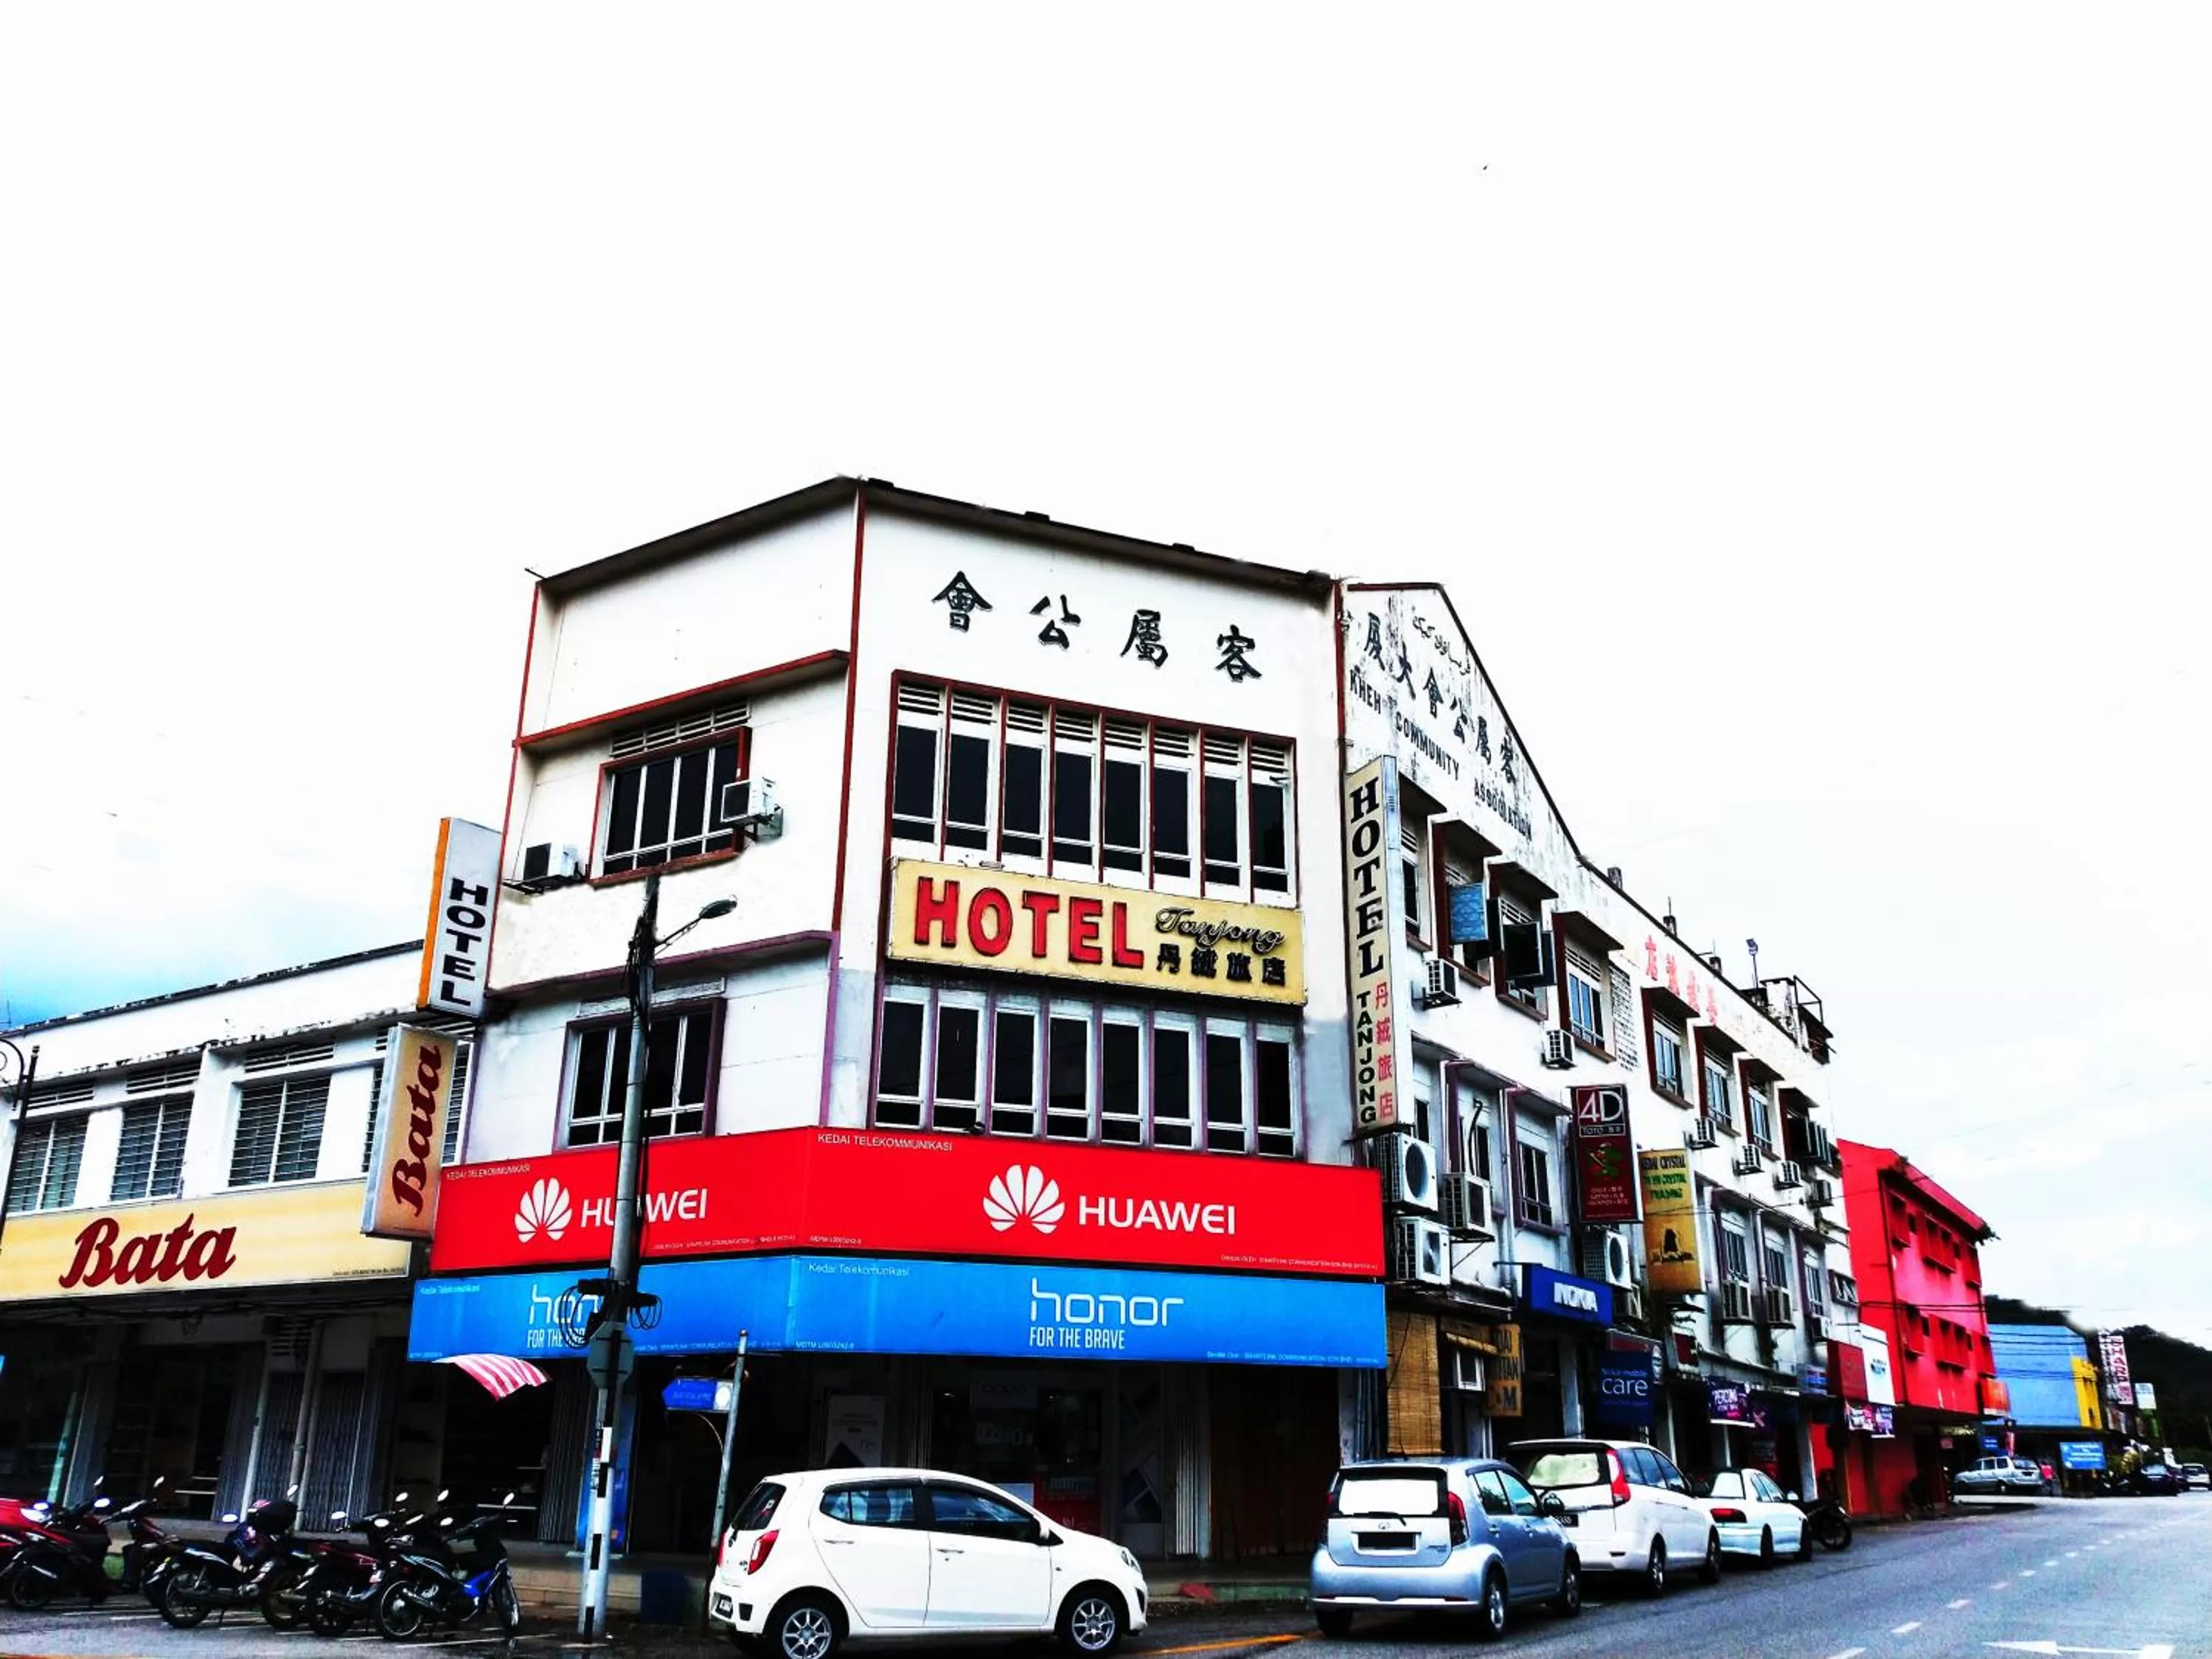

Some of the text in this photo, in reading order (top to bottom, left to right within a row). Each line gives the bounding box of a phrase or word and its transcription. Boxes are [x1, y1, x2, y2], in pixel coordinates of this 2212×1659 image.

[1350, 667, 1381, 714] KHEH
[1396, 710, 1459, 781] COMMUNITY
[1350, 776, 1385, 979] HOTEL
[441, 877, 488, 1007] HOTEL
[914, 875, 1144, 969] HOTEL
[1155, 906, 1287, 953] Tanjong
[1356, 990, 1377, 1124] TANJONG
[391, 1043, 442, 1218] Bata
[1579, 1091, 1623, 1123] 4D
[818, 1133, 849, 1144] KEDAI
[1079, 1194, 1236, 1234] HUAWEI
[58, 1213, 237, 1289] Bata
[1031, 1277, 1184, 1326] honor
[527, 1329, 544, 1349] FOR
[1030, 1326, 1125, 1350] FOR THE BRAVE
[1601, 1377, 1649, 1397] care
